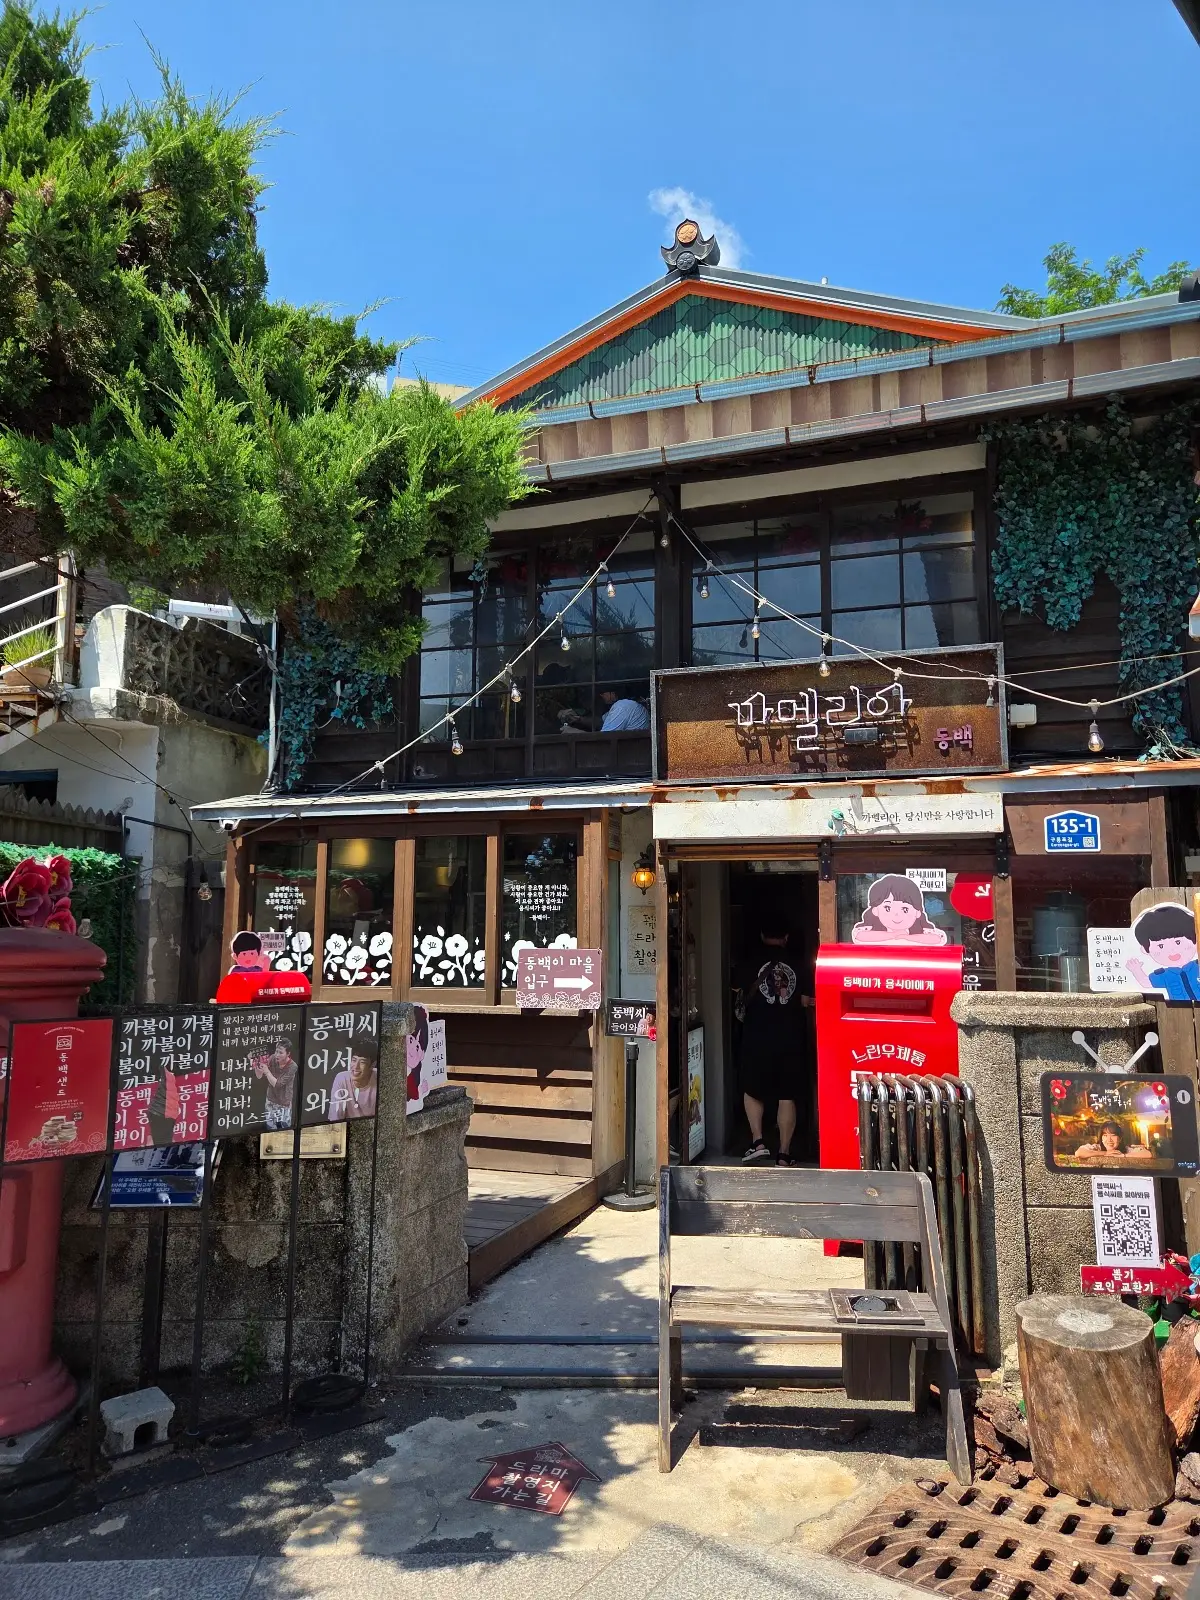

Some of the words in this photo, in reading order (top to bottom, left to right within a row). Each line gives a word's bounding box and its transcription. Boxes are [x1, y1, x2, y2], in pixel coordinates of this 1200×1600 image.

[728, 683, 912, 750] 까멜리아
[933, 725, 973, 750] 동백
[905, 811, 942, 821] 당신만을
[945, 809, 994, 820] 사랑합니다
[1051, 818, 1092, 833] 135-1
[634, 933, 656, 943] 드라
[634, 949, 656, 966] 촬영
[1095, 948, 1121, 958] 동백이
[525, 956, 564, 970] 동백이
[569, 956, 595, 974] 마을
[1095, 962, 1121, 972] 마을로
[524, 973, 549, 990] 입구
[843, 977, 882, 988] 동백이가
[885, 979, 935, 991] 용식이에게
[223, 1015, 245, 1025] 봤지?
[611, 1006, 646, 1020] 동백씨
[123, 1016, 174, 1037] 까불이
[182, 1014, 214, 1032] 까불
[222, 1028, 231, 1037] 내
[234, 1025, 258, 1036] 분명히
[308, 1010, 378, 1041] 동백씨
[119, 1037, 133, 1056] 이
[141, 1033, 192, 1054] 까불이
[118, 1055, 151, 1076] 불이
[160, 1050, 209, 1072] 까불이
[307, 1046, 353, 1074] 어서
[56, 1052, 69, 1096] 동백샌드
[117, 1087, 152, 1108] 동백
[178, 1081, 210, 1100] 동백
[304, 1088, 360, 1115] 와유!
[194, 1101, 208, 1118] 동
[114, 1127, 145, 1147] 백이
[172, 1119, 204, 1139] 백이
[1112, 1268, 1134, 1281] 뽑기
[1093, 1280, 1115, 1293] 코인
[1120, 1281, 1154, 1293] 교환기
[507, 1461, 569, 1479] 드라마
[501, 1472, 561, 1492] 촬영지
